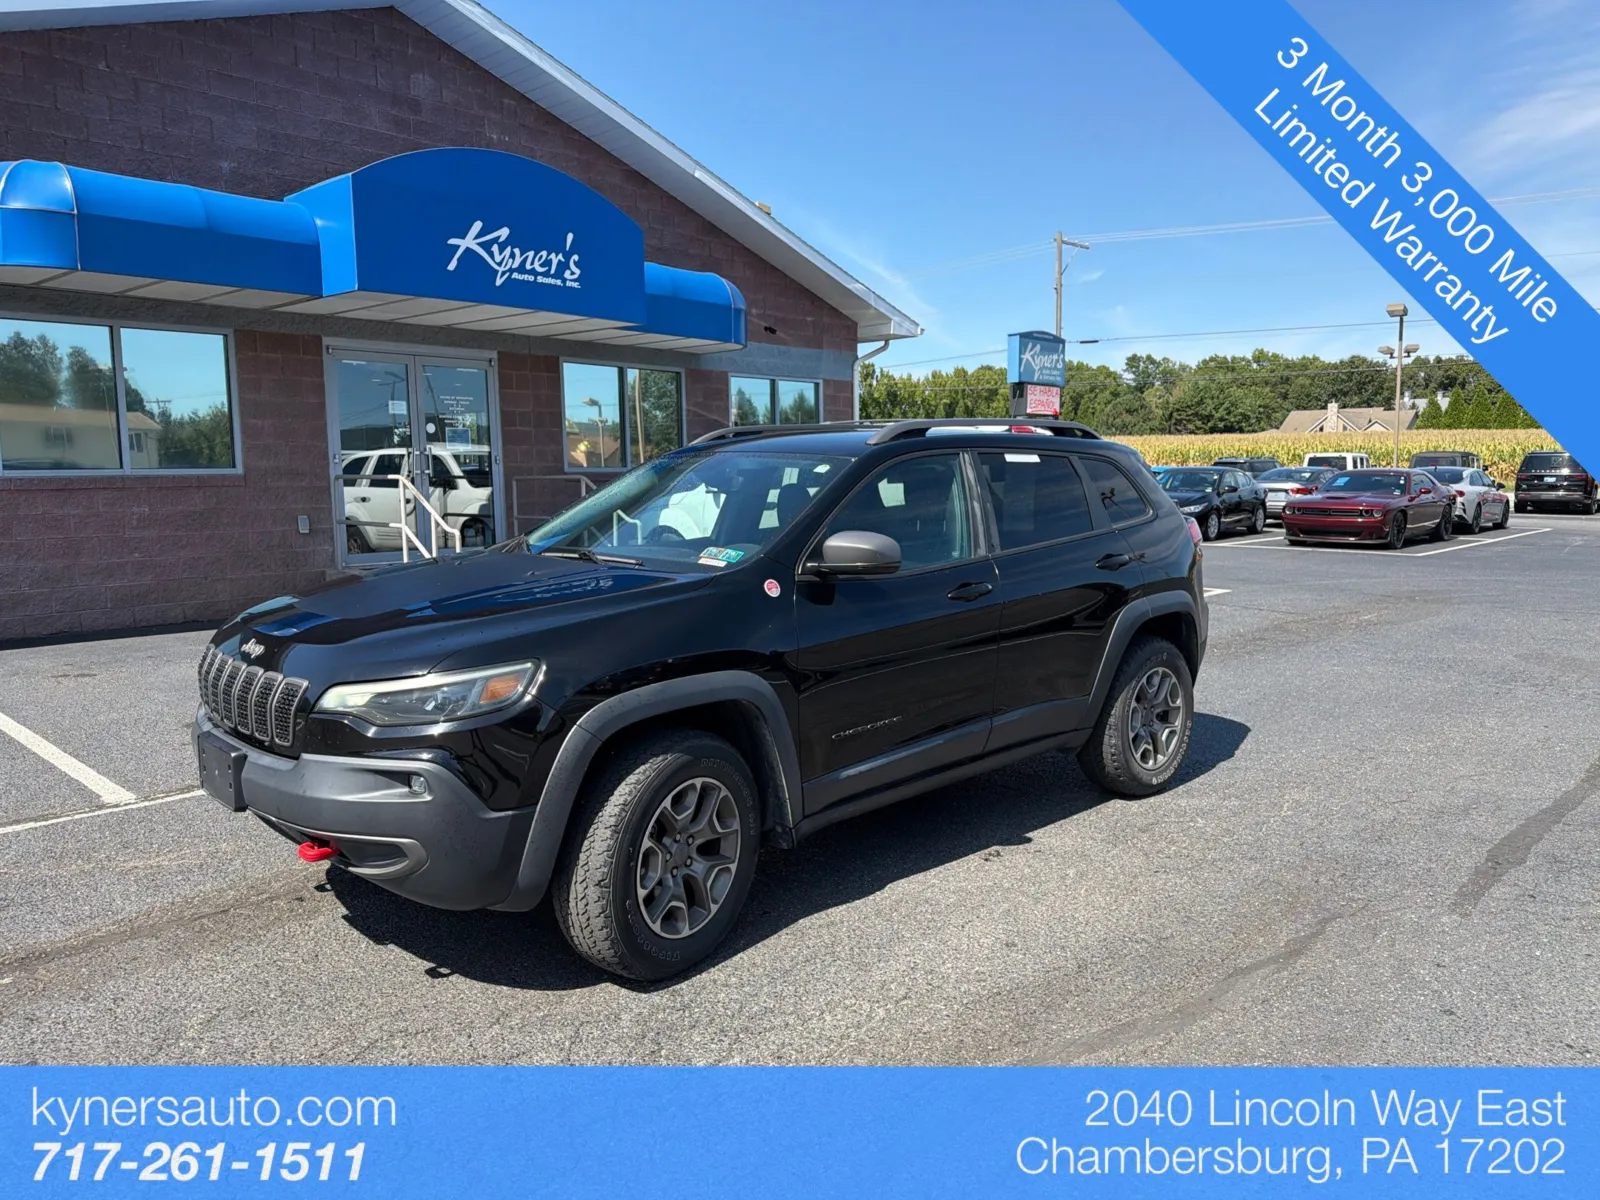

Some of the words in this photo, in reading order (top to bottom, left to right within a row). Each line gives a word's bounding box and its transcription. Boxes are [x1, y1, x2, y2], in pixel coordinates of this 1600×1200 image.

[446, 220, 581, 287] Kyner's
[511, 272, 535, 282] Auto
[536, 276, 564, 287] Sales,
[1020, 342, 1063, 382] Kyner's
[831, 715, 902, 740] CHEROKEE
